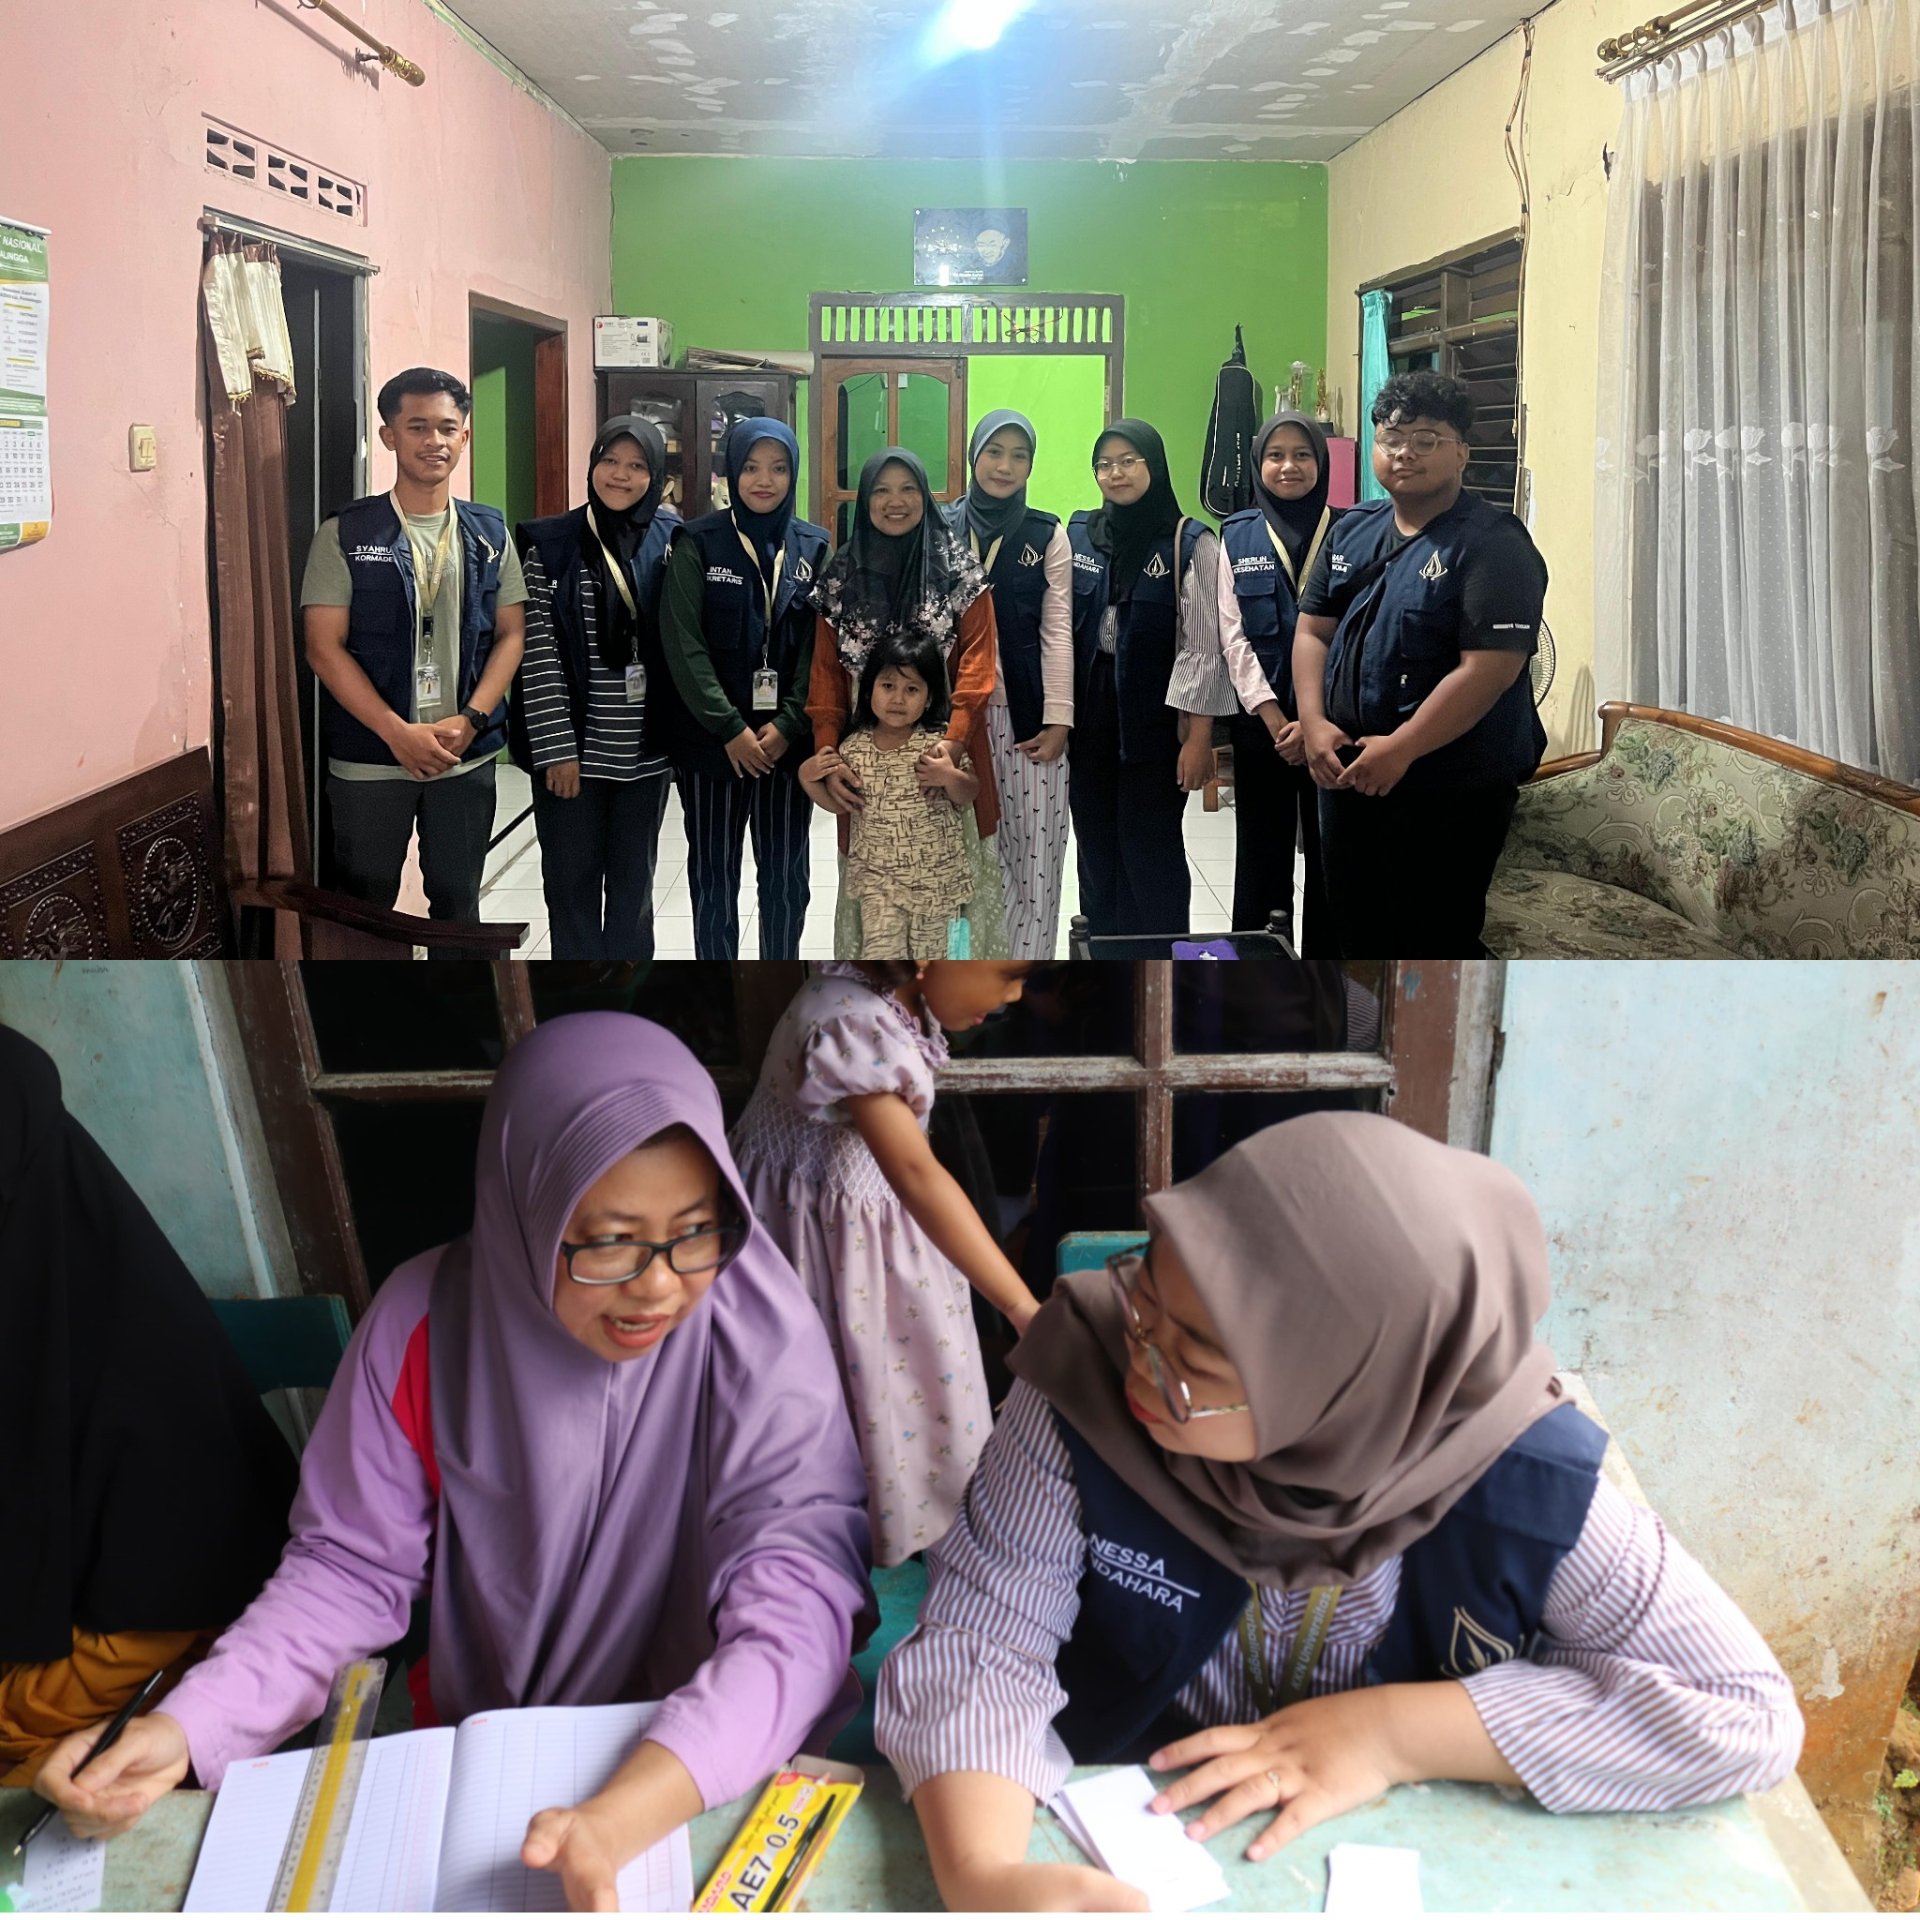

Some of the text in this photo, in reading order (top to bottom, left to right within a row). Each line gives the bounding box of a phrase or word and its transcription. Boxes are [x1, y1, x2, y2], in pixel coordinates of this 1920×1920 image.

[3, 236, 43, 254] NASIONAL
[710, 566, 732, 575] INTAN
[1238, 556, 1267, 565] SHERLIN
[1090, 1533, 1165, 1577] NESSA
[1299, 1592, 1331, 1662] Universitas
[730, 1855, 772, 1911] AE7
[766, 1814, 800, 1849] 0.5
